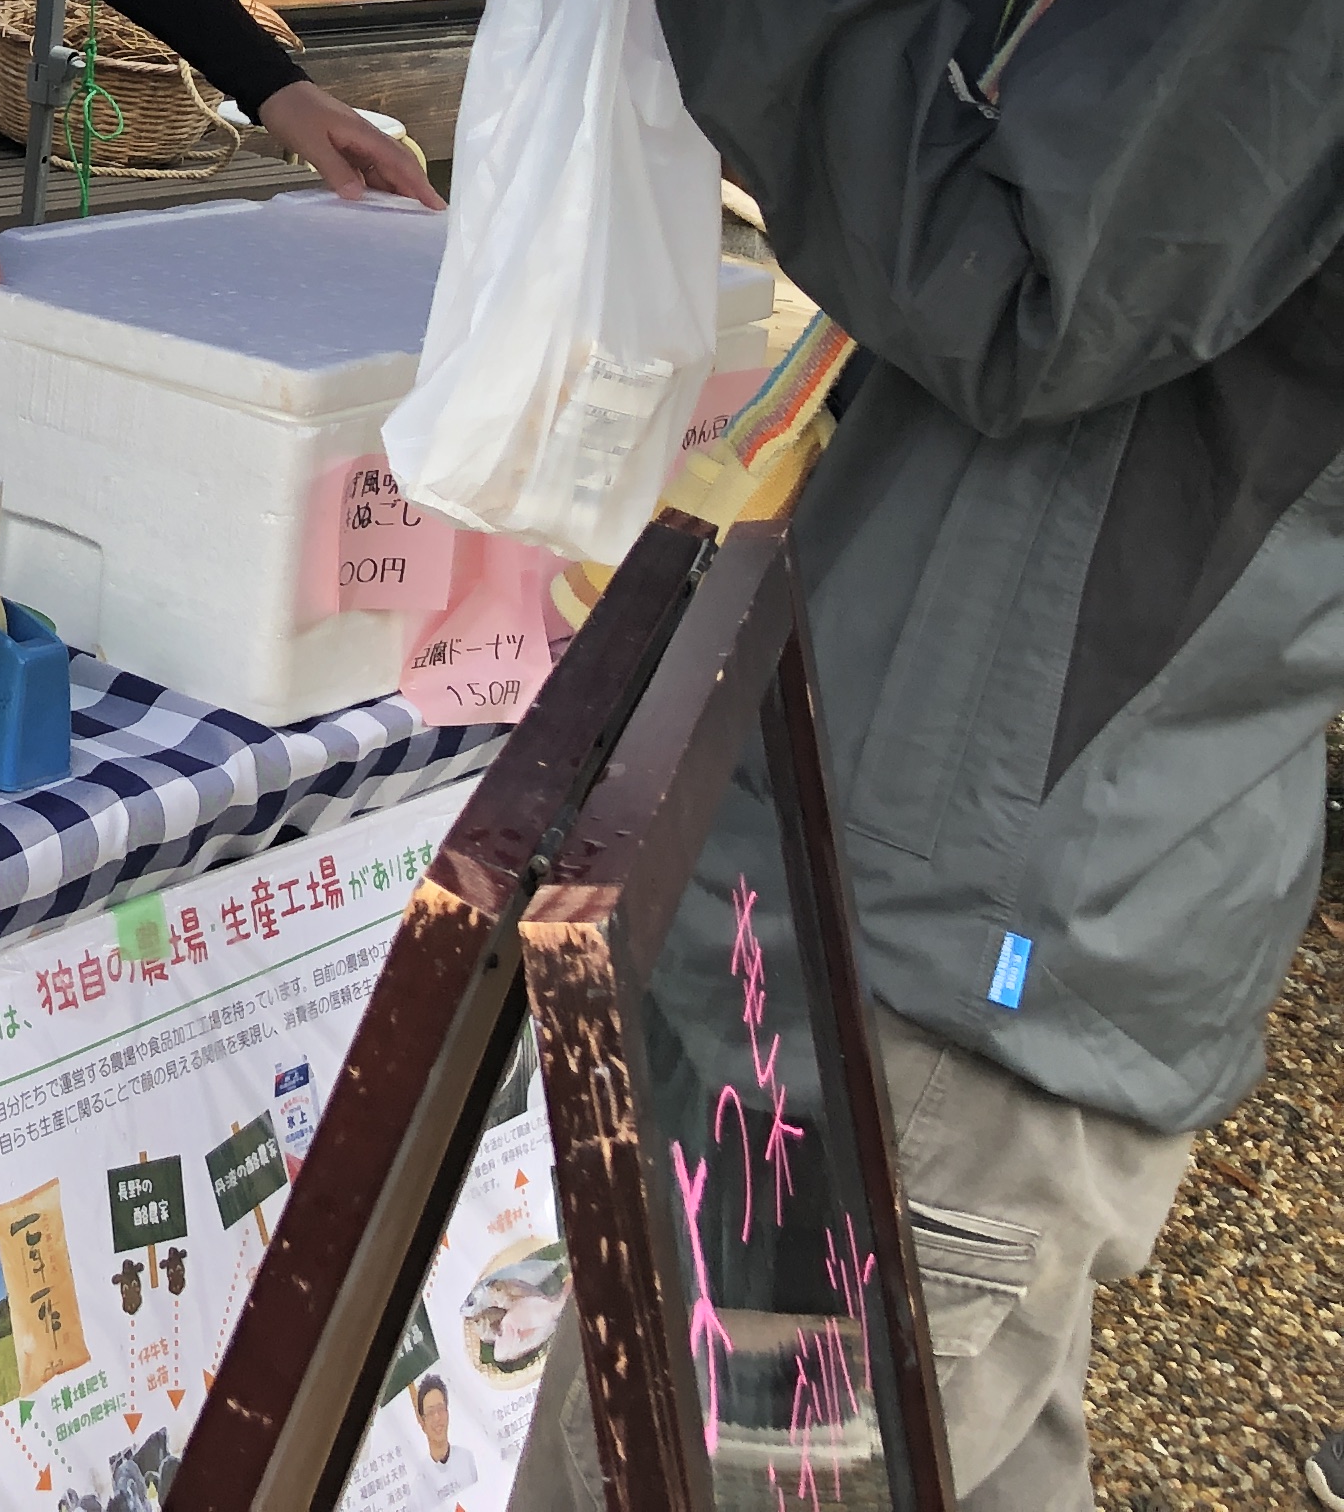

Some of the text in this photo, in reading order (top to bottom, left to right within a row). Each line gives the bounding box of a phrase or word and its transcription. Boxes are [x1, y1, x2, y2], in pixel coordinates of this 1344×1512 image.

[411, 633, 525, 670] 豆腐ドーナツ
[446, 679, 521, 707] 150円
[214, 1138, 278, 1197] 丹波の酪農家
[117, 1178, 153, 1201] 長野の
[133, 1199, 170, 1227] 酪農家
